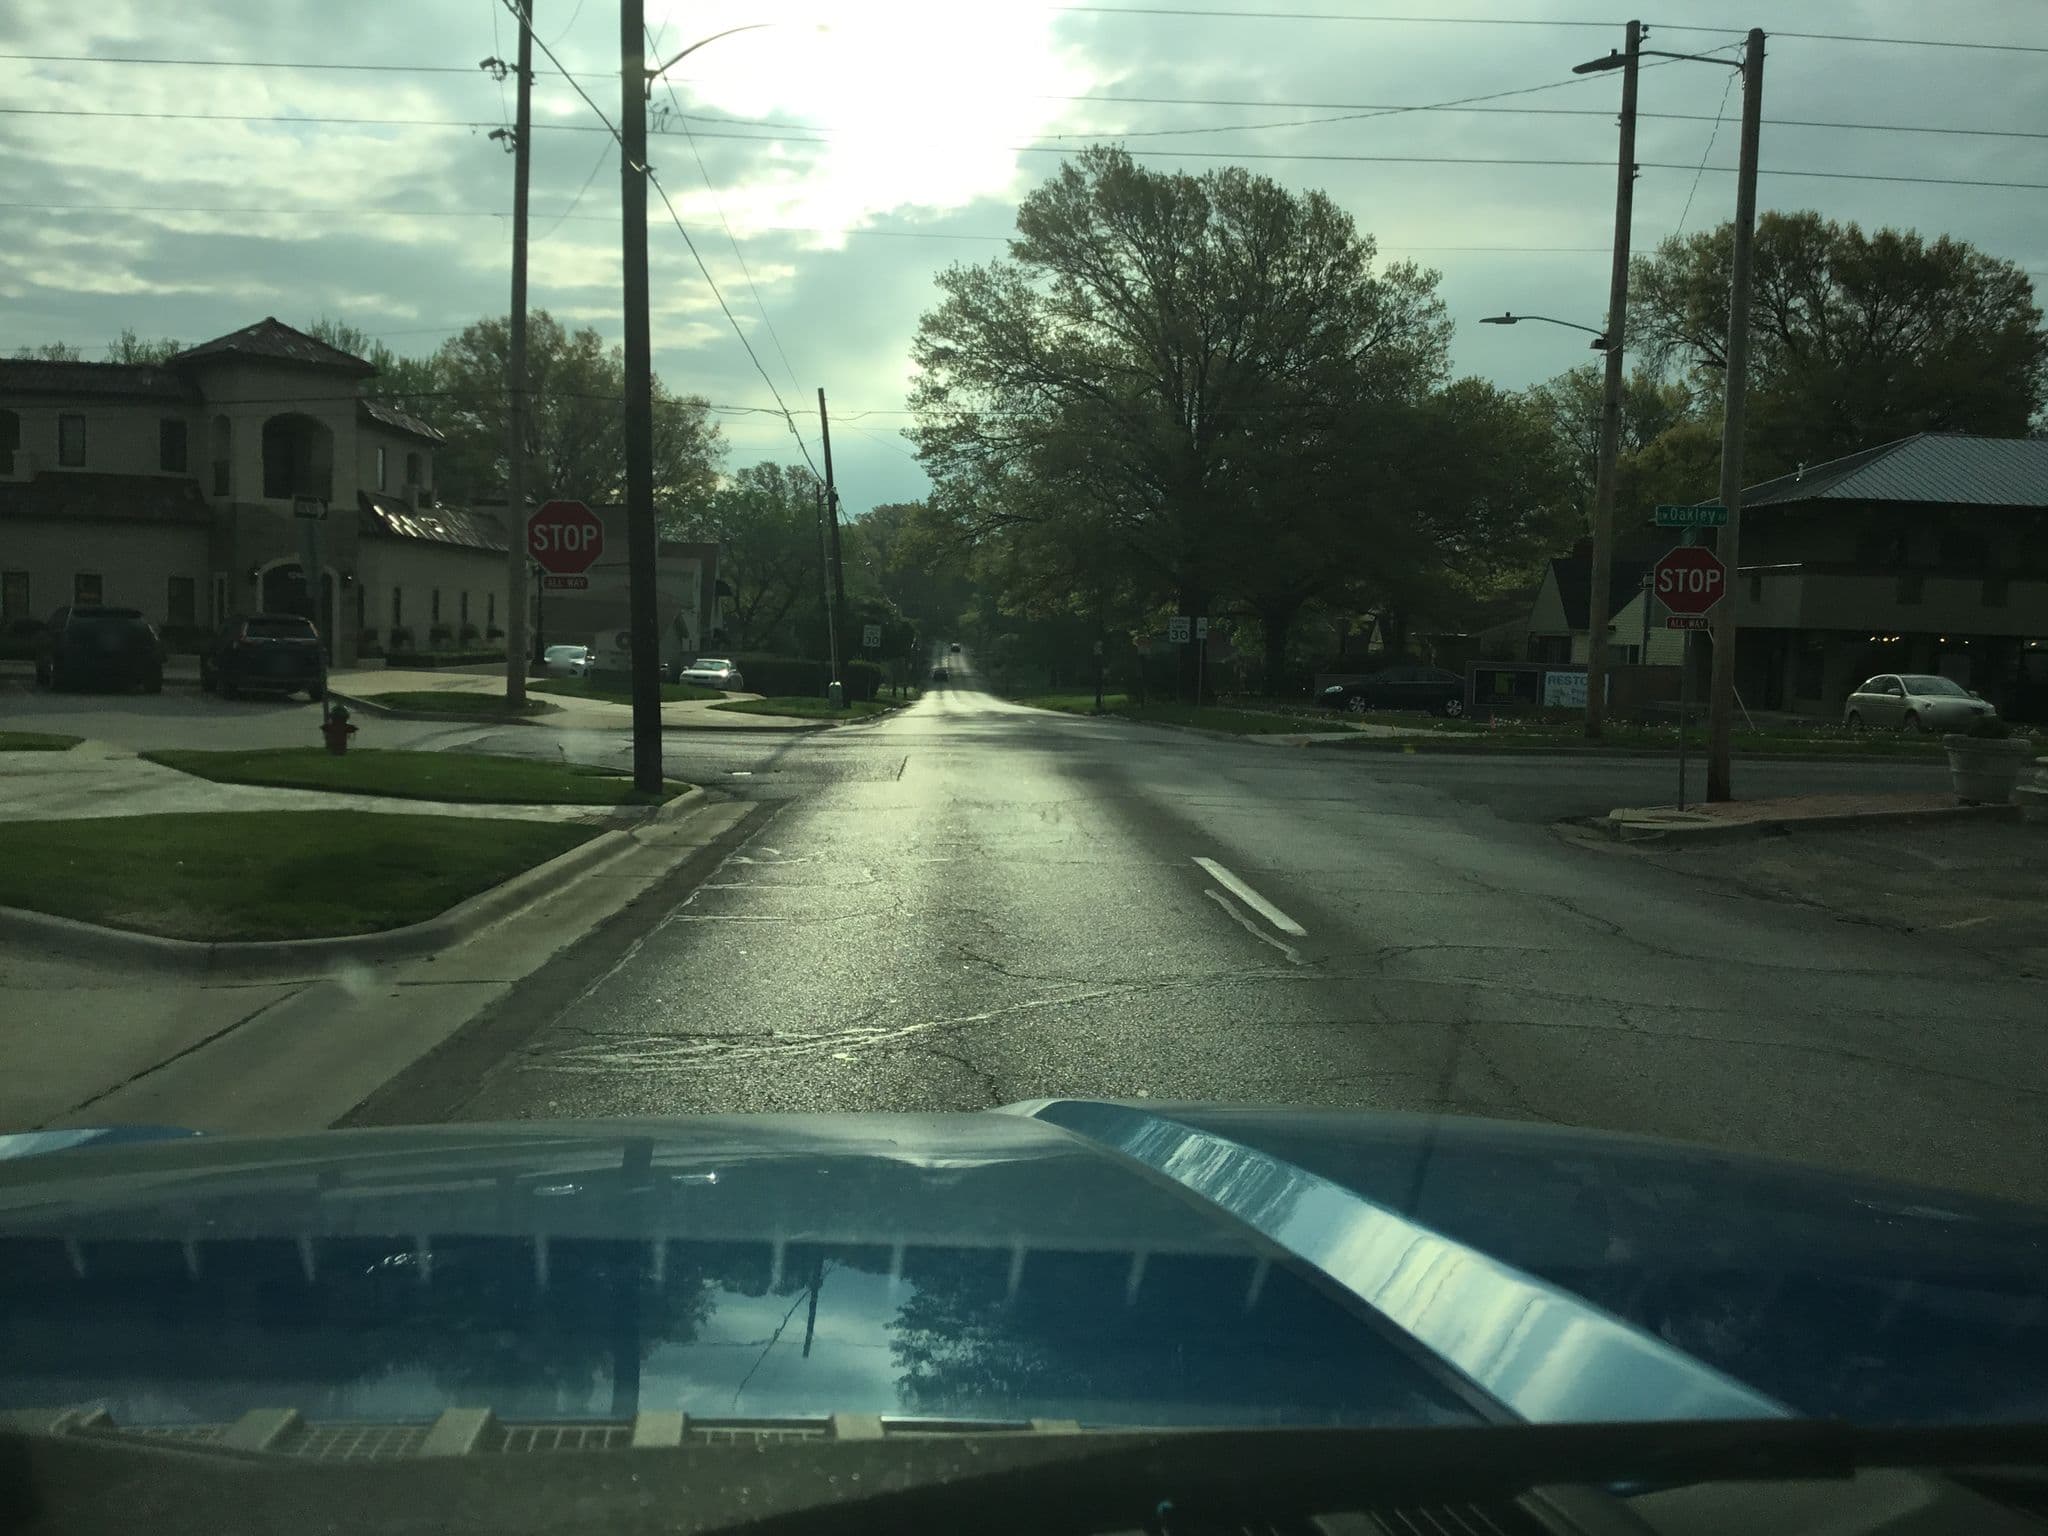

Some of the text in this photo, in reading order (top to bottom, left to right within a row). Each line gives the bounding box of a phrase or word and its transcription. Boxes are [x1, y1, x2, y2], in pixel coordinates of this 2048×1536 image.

[1670, 508, 1716, 524] Oakley
[534, 524, 598, 552] STOP
[1658, 568, 1721, 593] STOP
[1670, 619, 1705, 628] ALL WAY
[1172, 630, 1187, 640] 30
